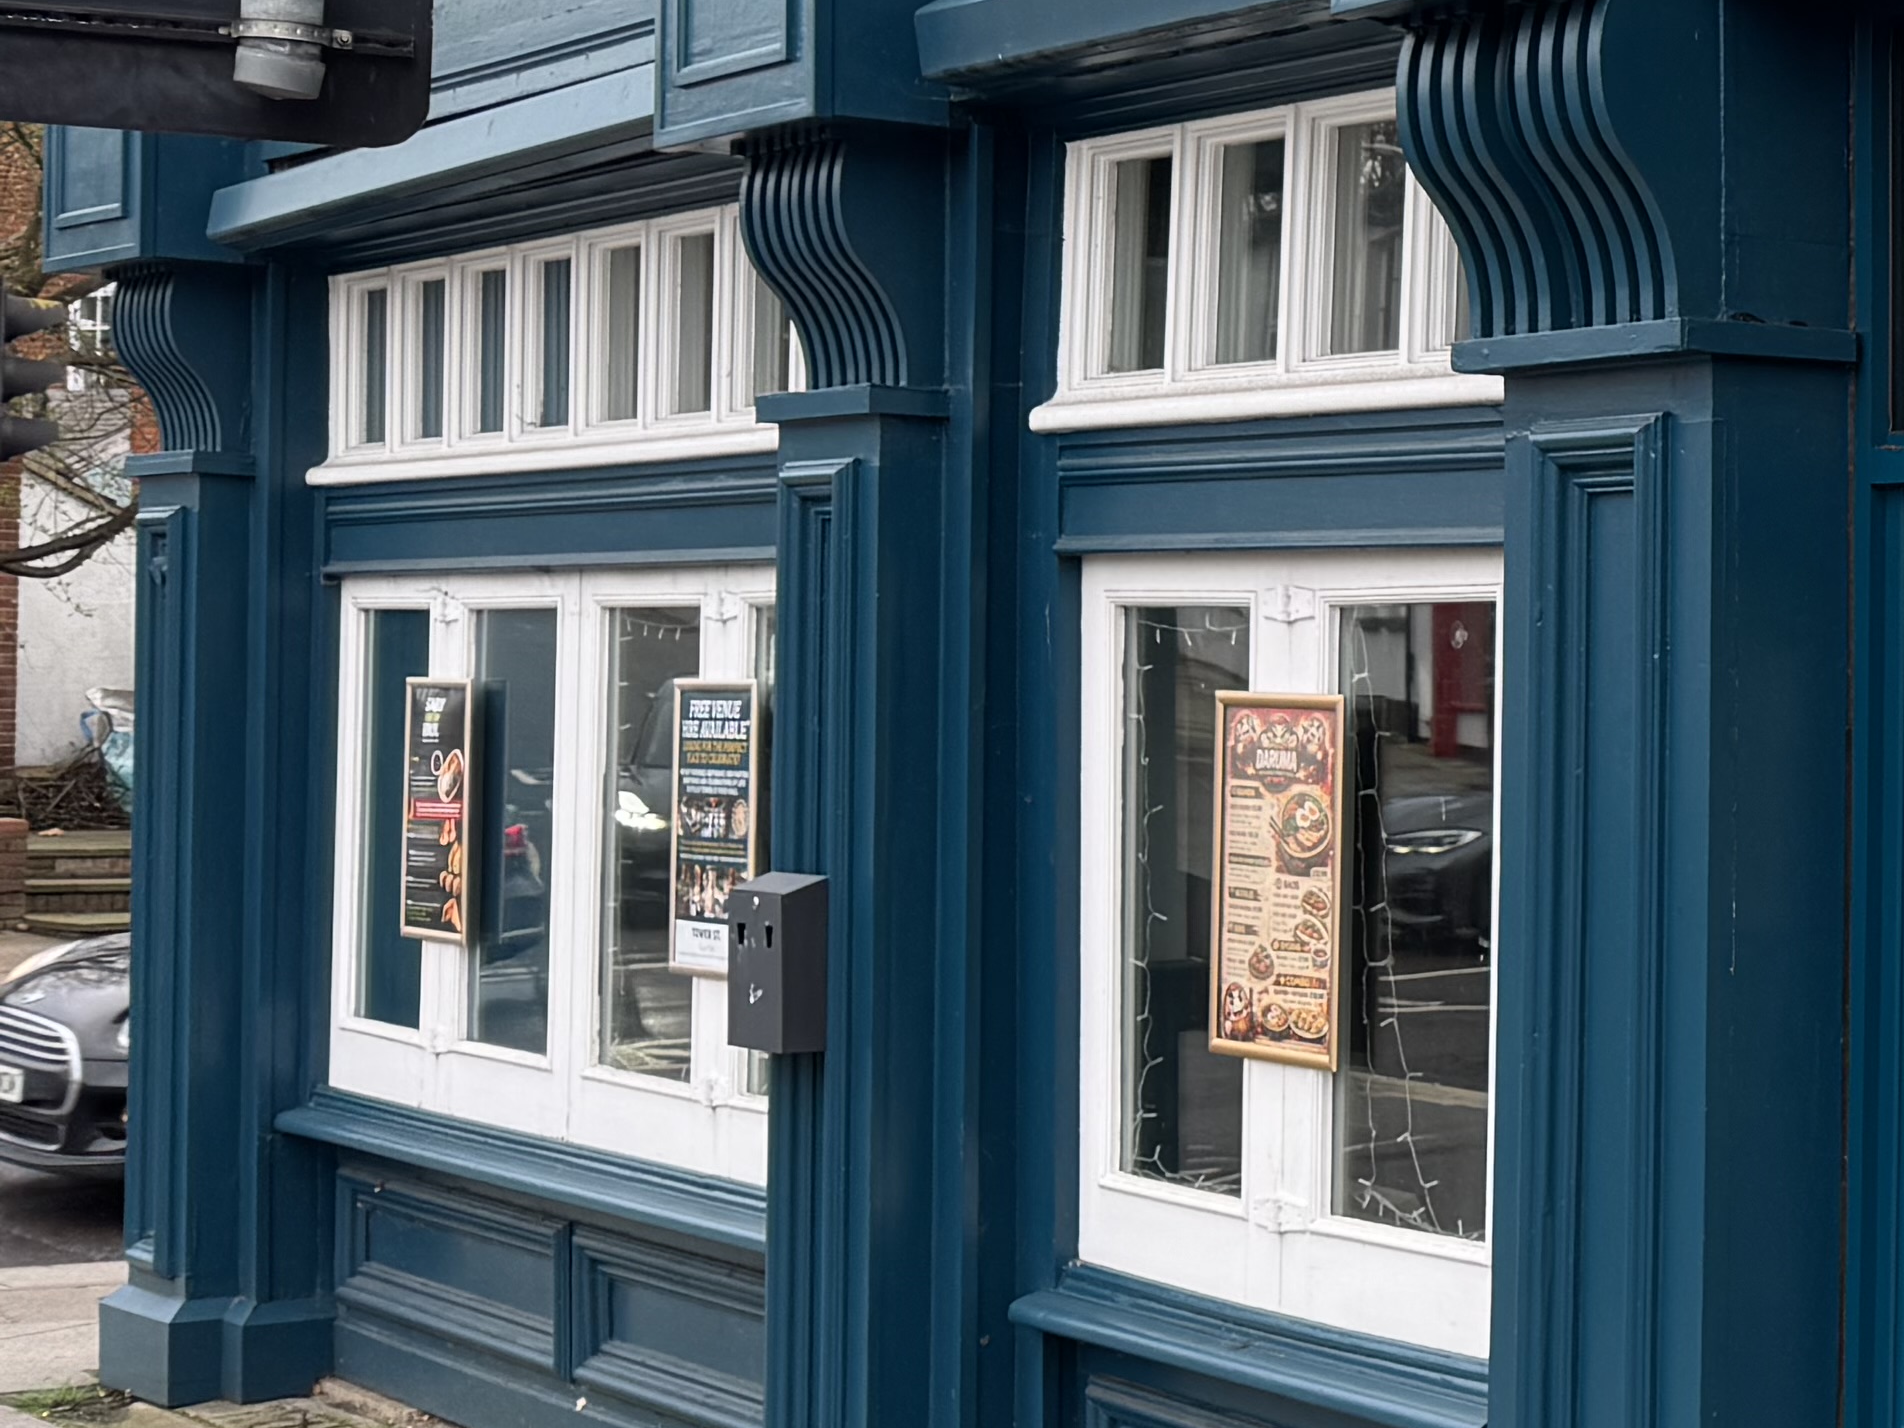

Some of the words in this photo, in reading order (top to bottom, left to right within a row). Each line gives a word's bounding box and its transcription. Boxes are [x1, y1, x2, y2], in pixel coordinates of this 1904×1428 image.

[689, 699, 711, 719] FREE
[711, 700, 742, 719] VENUE
[1255, 749, 1297, 772] DARUMA
